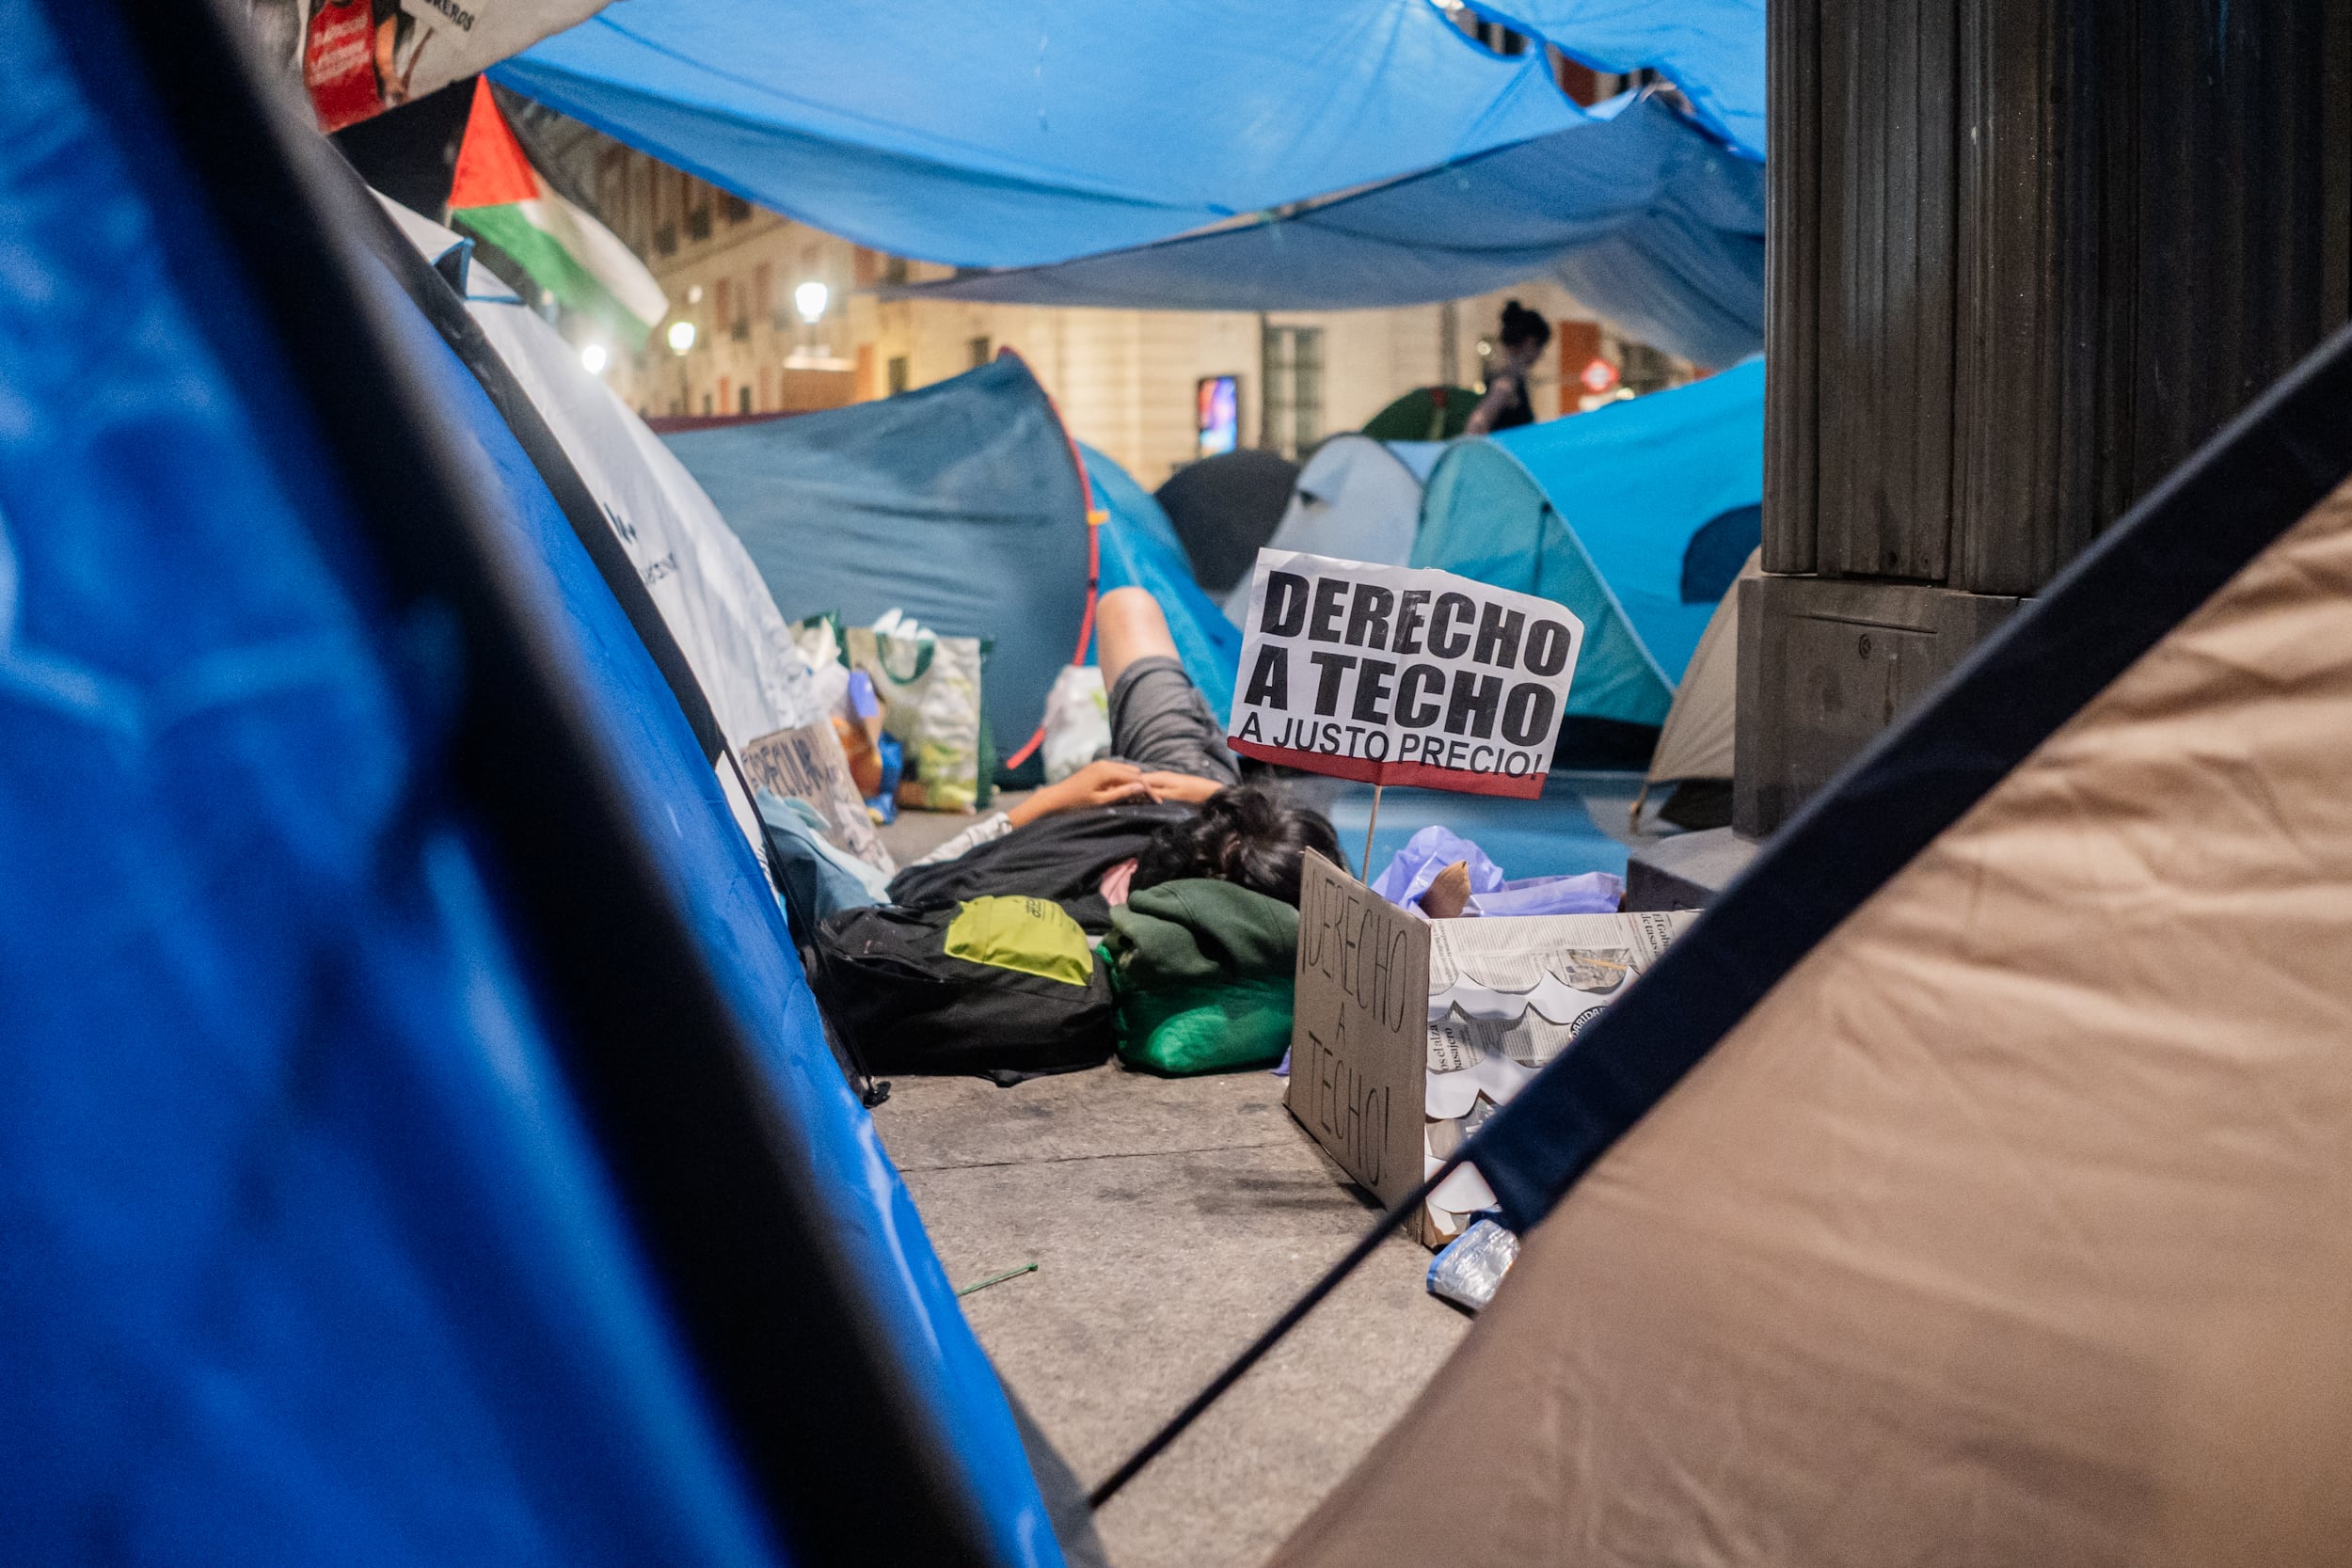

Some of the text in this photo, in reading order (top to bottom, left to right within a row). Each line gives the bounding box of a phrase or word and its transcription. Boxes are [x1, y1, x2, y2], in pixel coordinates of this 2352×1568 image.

[1260, 570, 1572, 676] DERECHO
[1238, 712, 1543, 781] A JUSTO PRECIO!
[1244, 643, 1556, 747] A TECHO
[1336, 1002, 1346, 1046] A
[1309, 1030, 1390, 1187] TECHO!
